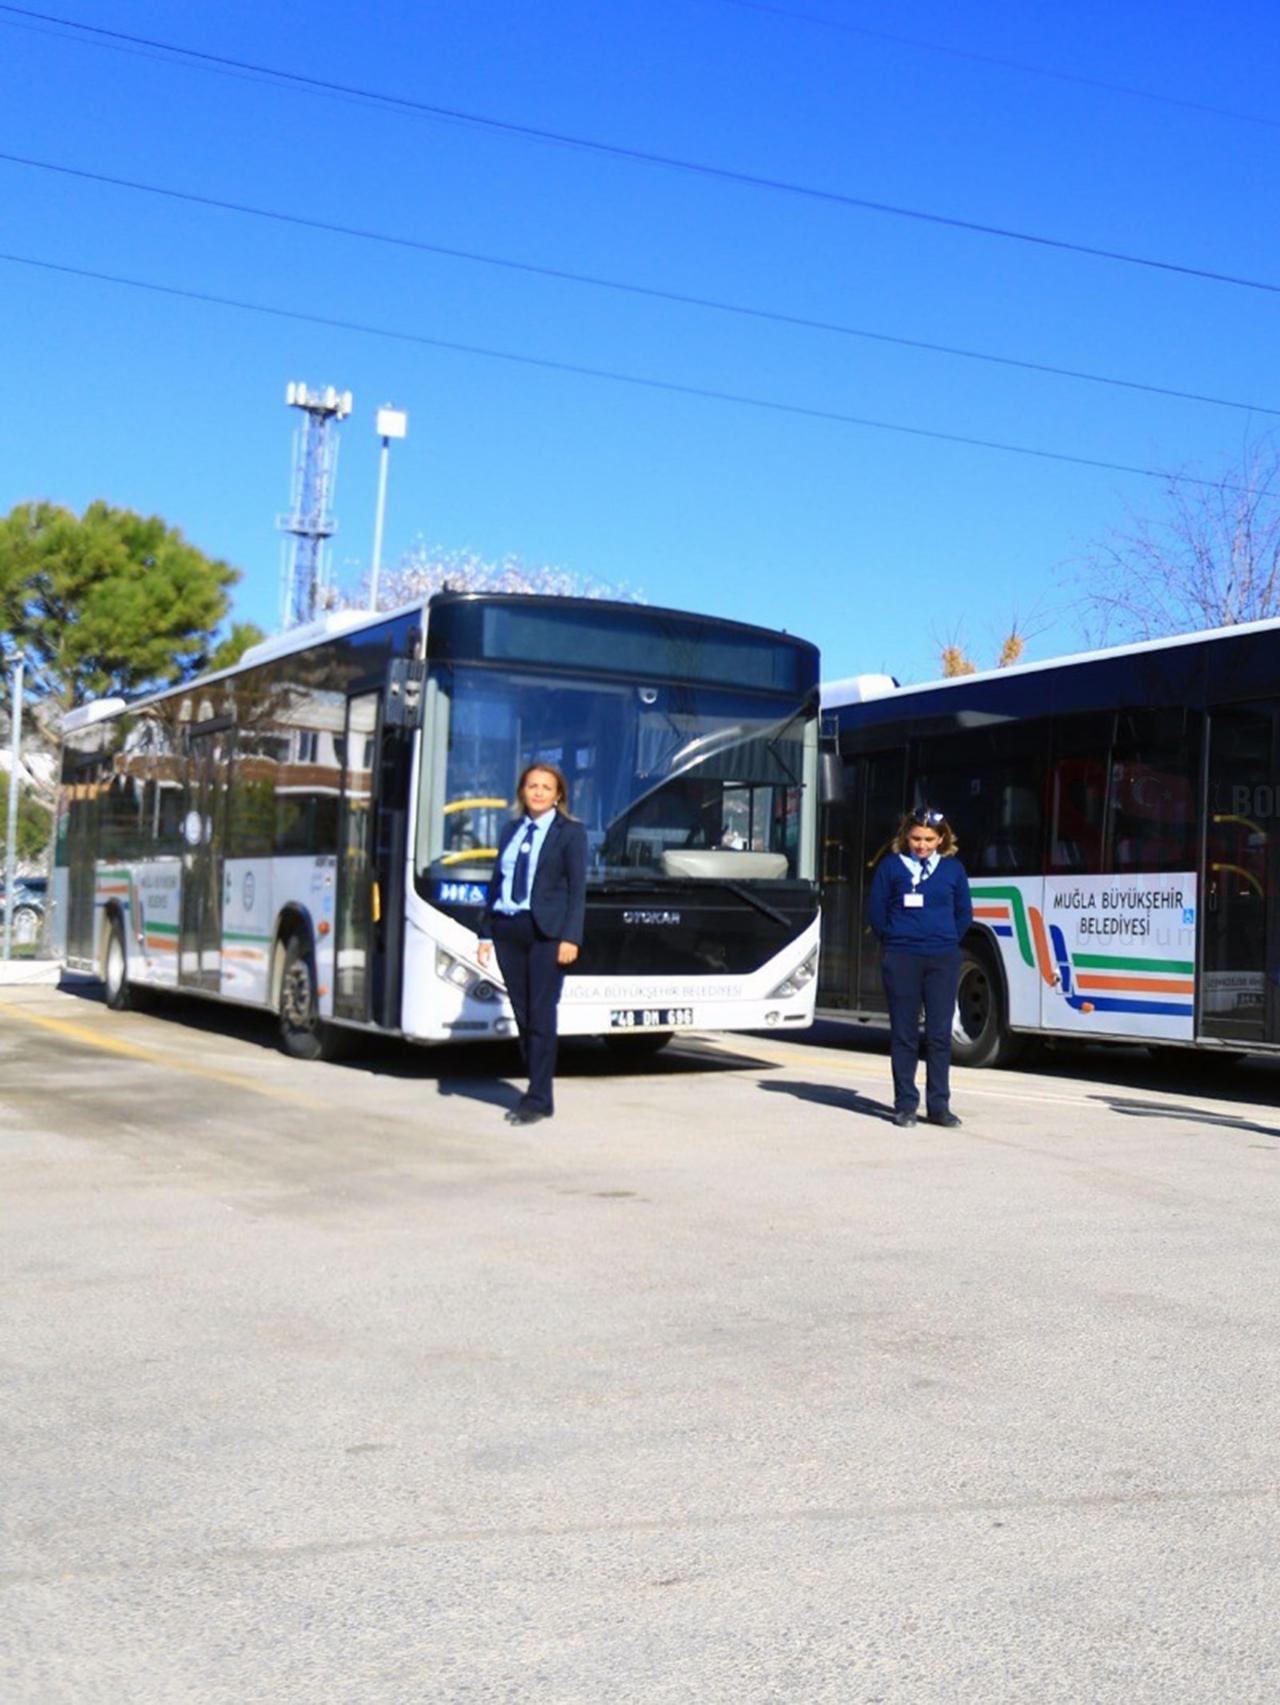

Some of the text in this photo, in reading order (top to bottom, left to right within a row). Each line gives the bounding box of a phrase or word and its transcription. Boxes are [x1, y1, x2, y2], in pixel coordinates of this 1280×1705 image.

[1053, 887, 1184, 911] MUĞLA BÜYÜKŞEHİR
[1080, 914, 1151, 936] BELEDİYESİ
[564, 983, 600, 999] UĞLA
